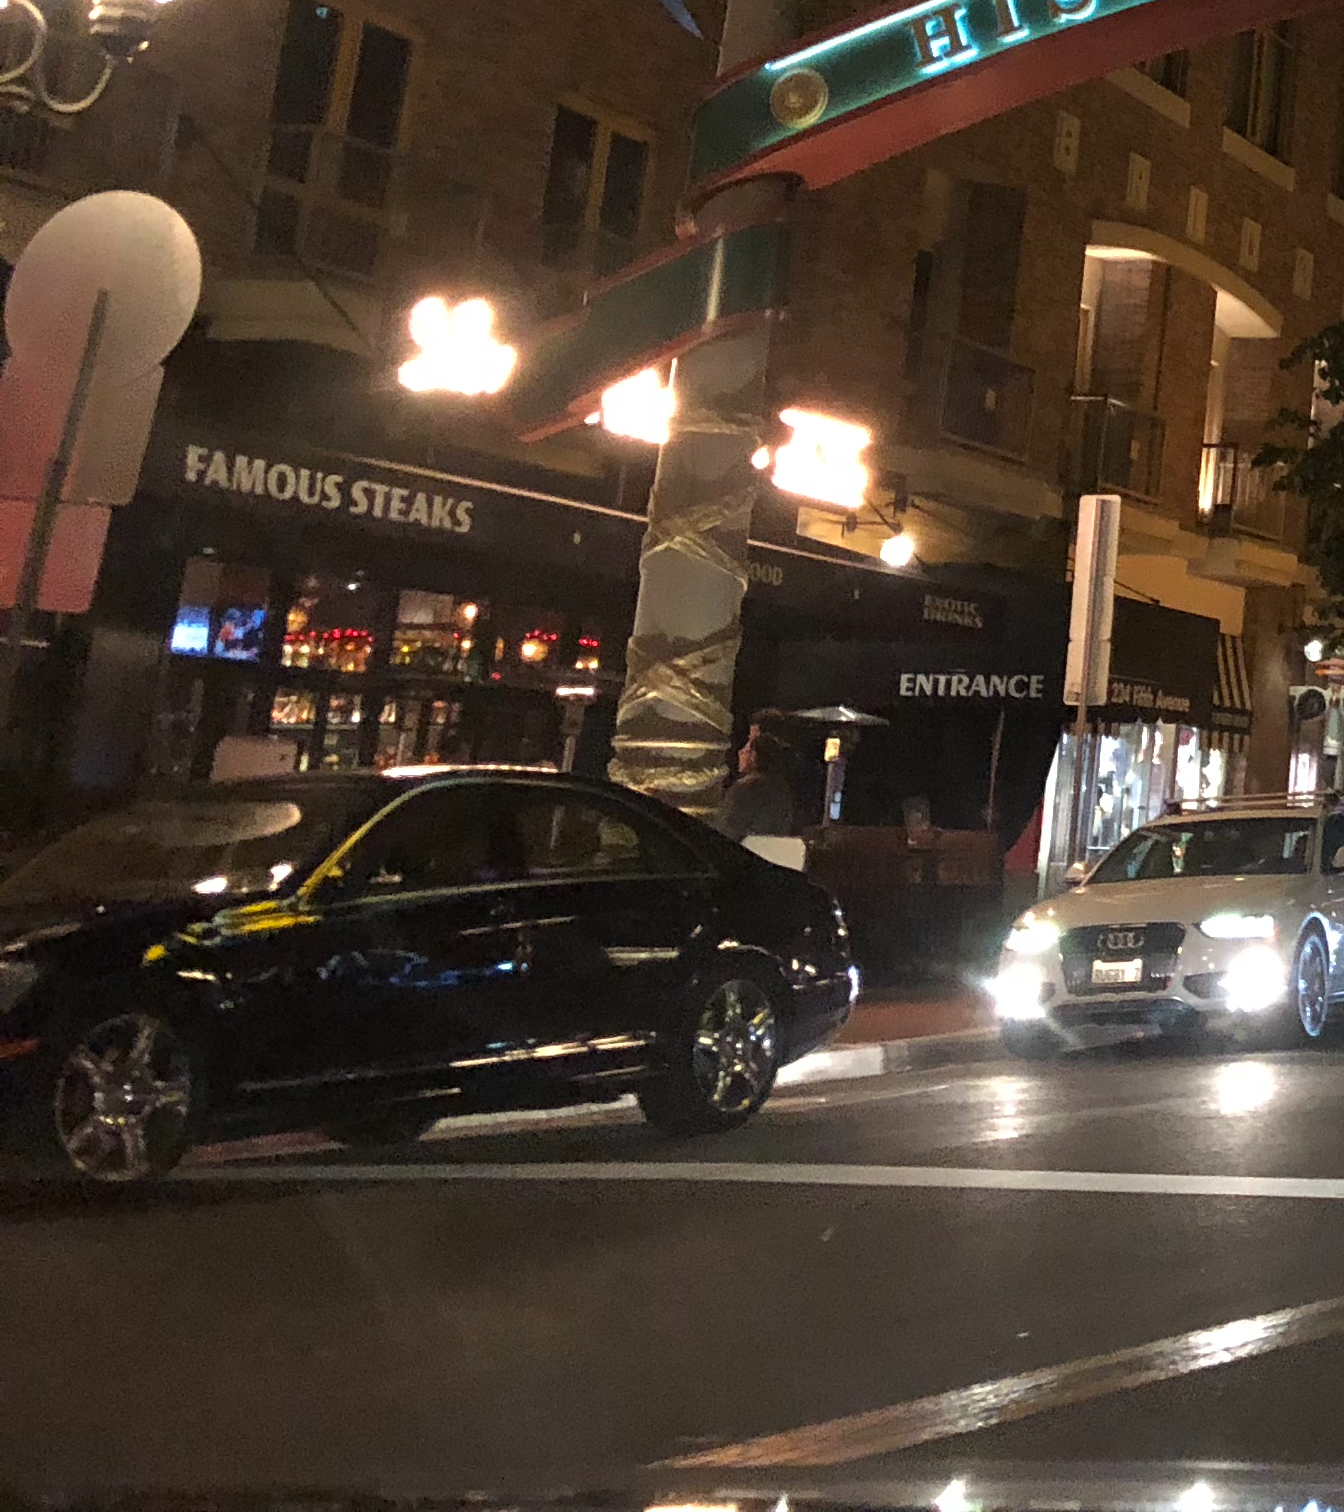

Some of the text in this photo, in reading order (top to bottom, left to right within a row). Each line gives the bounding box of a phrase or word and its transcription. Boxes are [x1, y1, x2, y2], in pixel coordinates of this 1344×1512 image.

[186, 444, 474, 534] FAMOUS STEAKS
[899, 672, 1045, 700] ENTRANCE
[1155, 689, 1191, 713] Avenue
